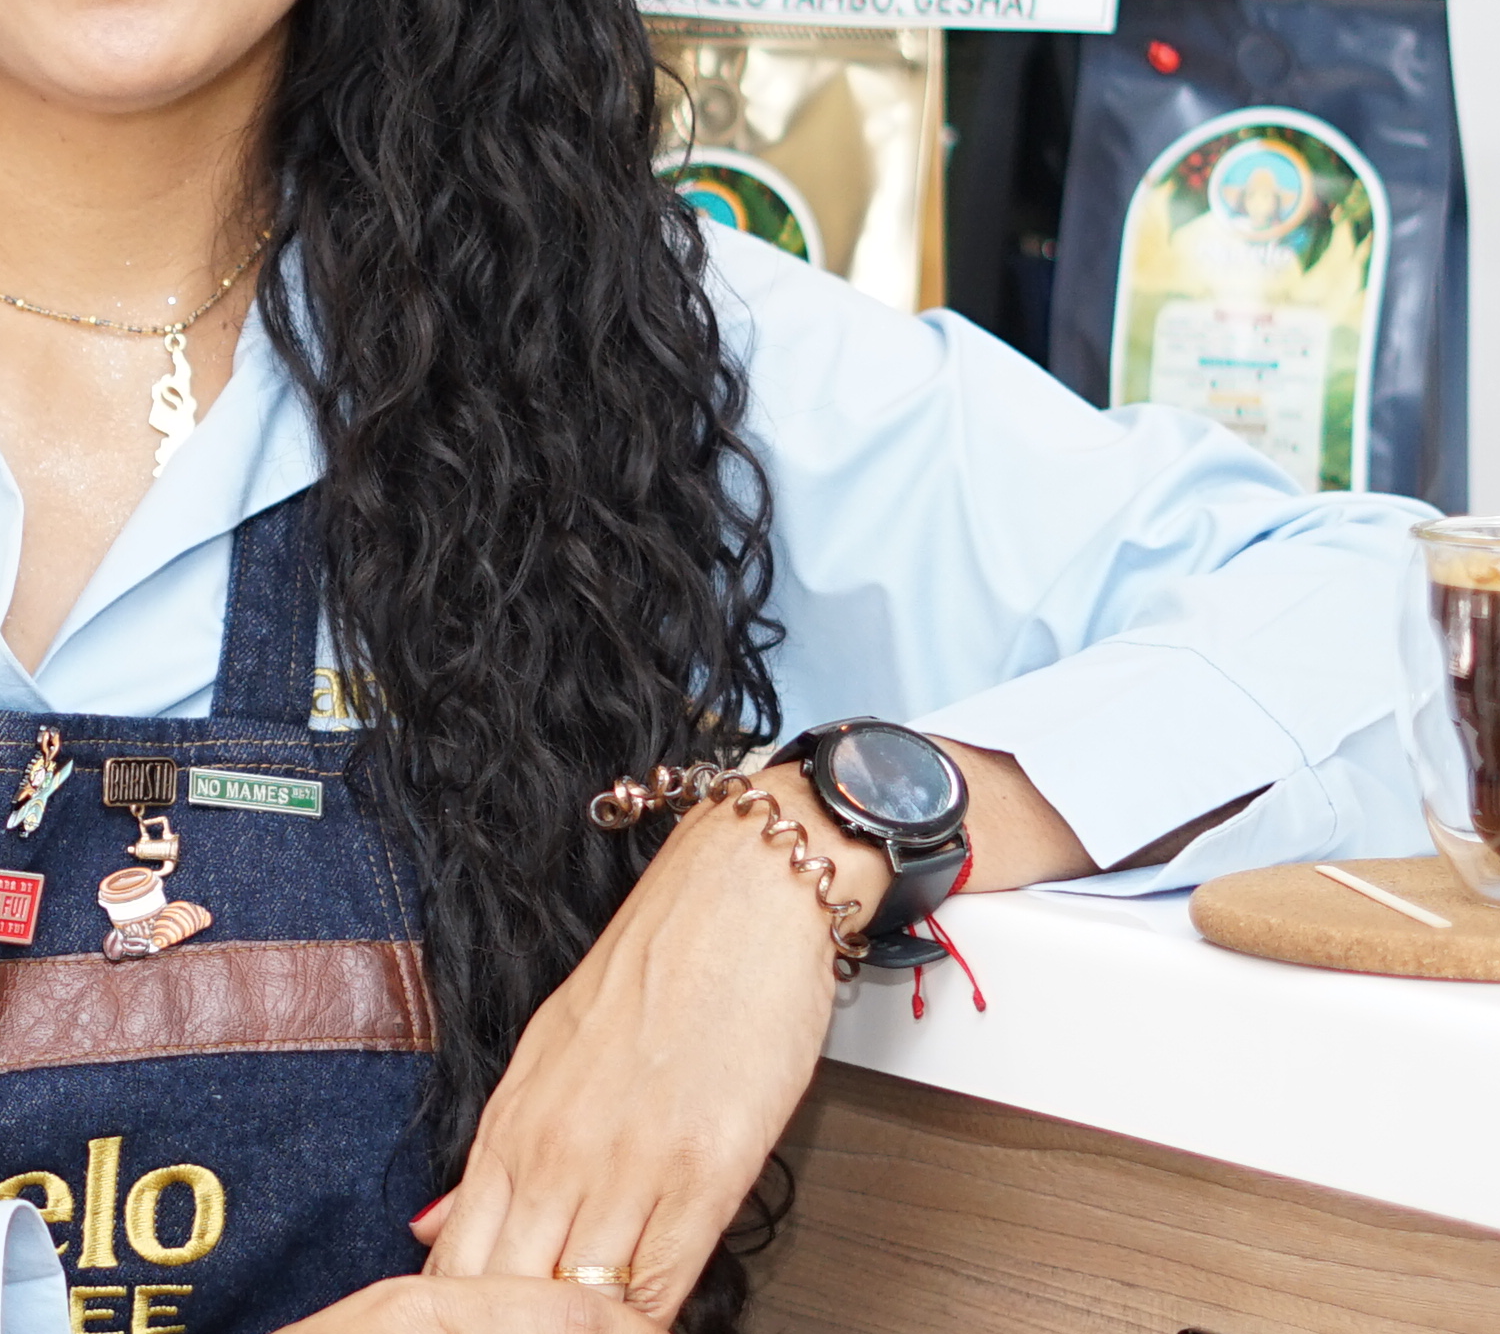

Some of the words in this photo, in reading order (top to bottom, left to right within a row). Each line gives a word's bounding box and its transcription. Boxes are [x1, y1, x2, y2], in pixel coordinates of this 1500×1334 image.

[109, 761, 174, 802] BARISTA
[197, 778, 221, 797] NO
[225, 781, 290, 805] MAMES
[2, 895, 28, 919] FUI
